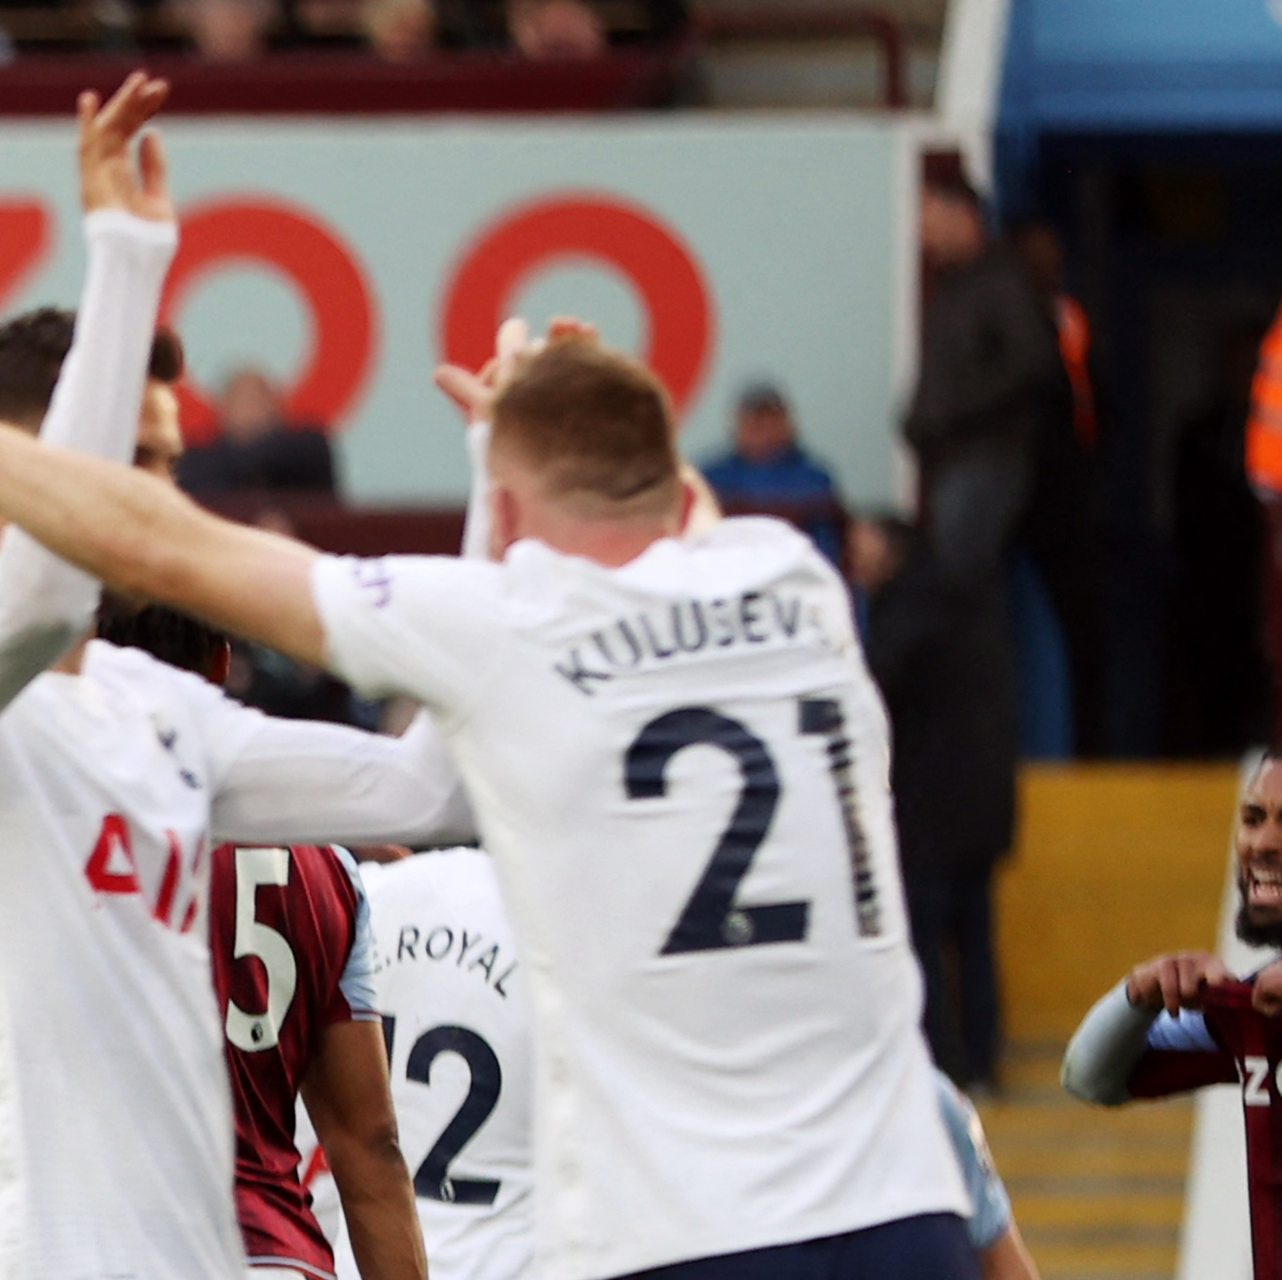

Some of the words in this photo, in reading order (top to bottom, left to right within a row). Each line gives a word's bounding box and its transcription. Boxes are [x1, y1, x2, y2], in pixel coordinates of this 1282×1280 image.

[554, 590, 845, 698] KULUSEV
[623, 697, 884, 957] 21
[225, 847, 297, 1053] 5
[373, 925, 521, 999] .ROYAL
